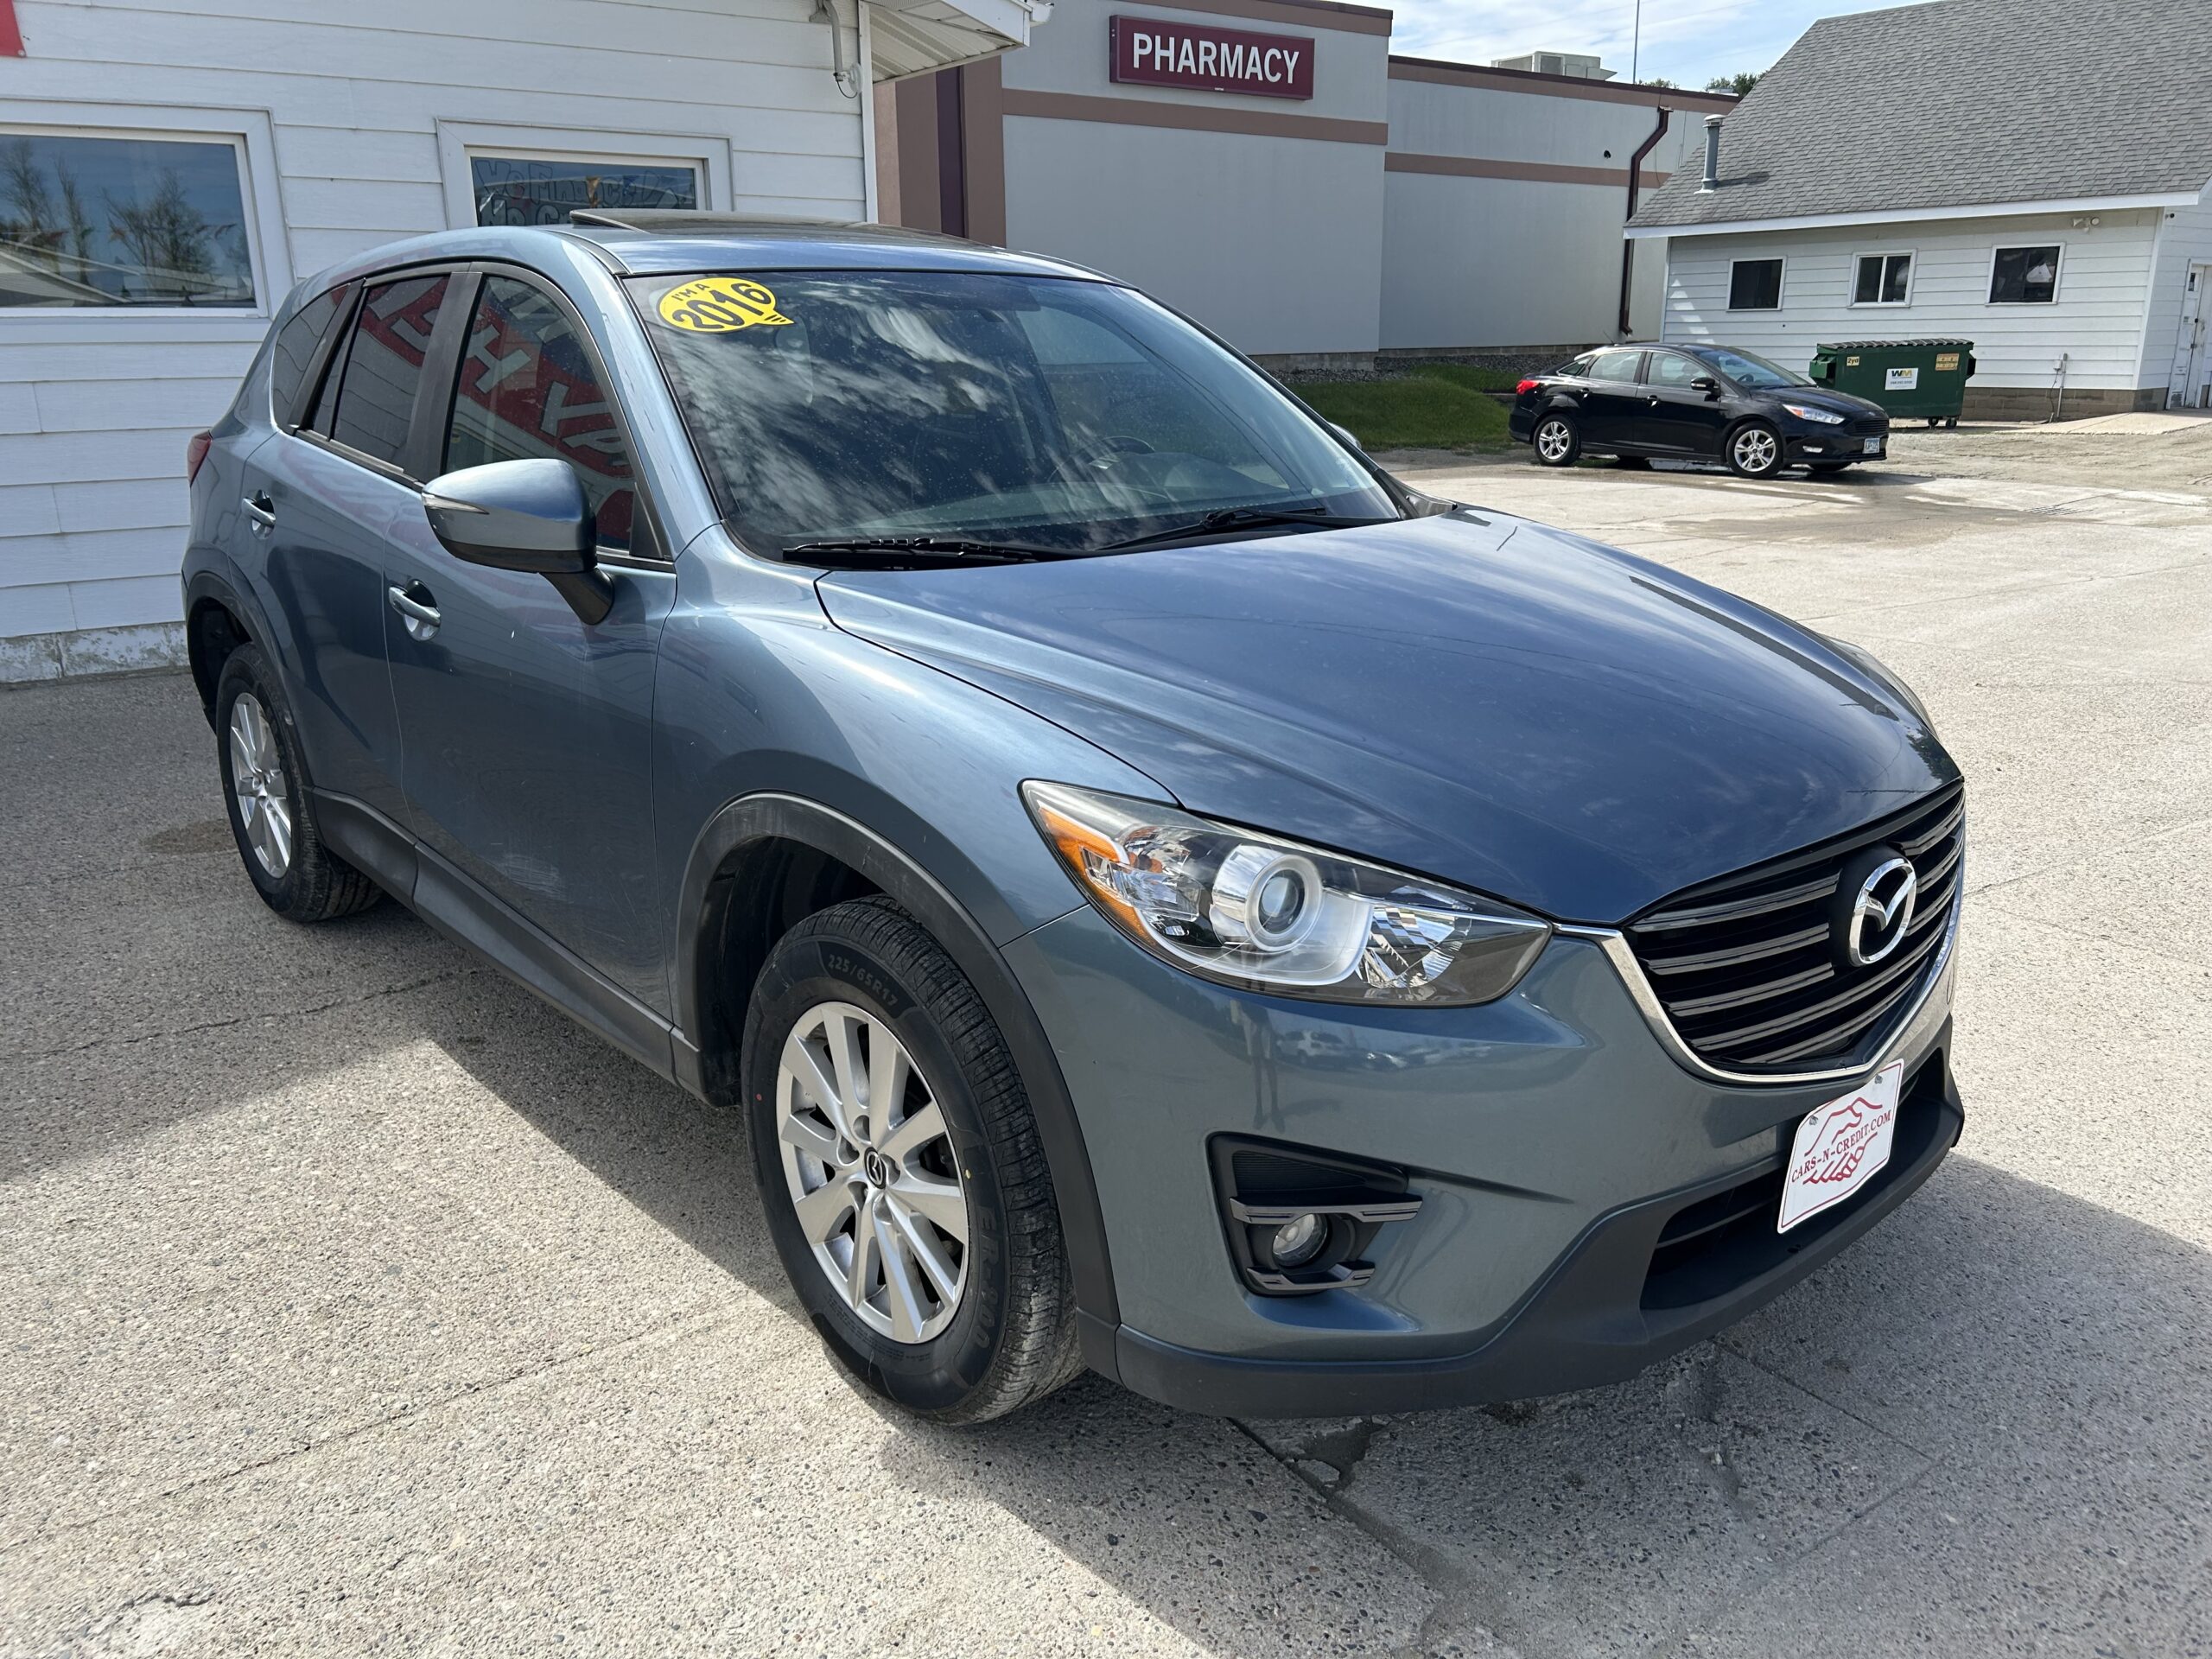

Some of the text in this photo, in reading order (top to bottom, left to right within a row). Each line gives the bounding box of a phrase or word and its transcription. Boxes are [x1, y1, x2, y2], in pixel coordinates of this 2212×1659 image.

[1132, 32, 1300, 84] PHARMACY
[671, 283, 711, 302] I'M A
[672, 283, 772, 329] 2016
[828, 953, 899, 1007] 225/65R17
[1791, 1109, 1891, 1183] CARS-N-CREDIT.COM
